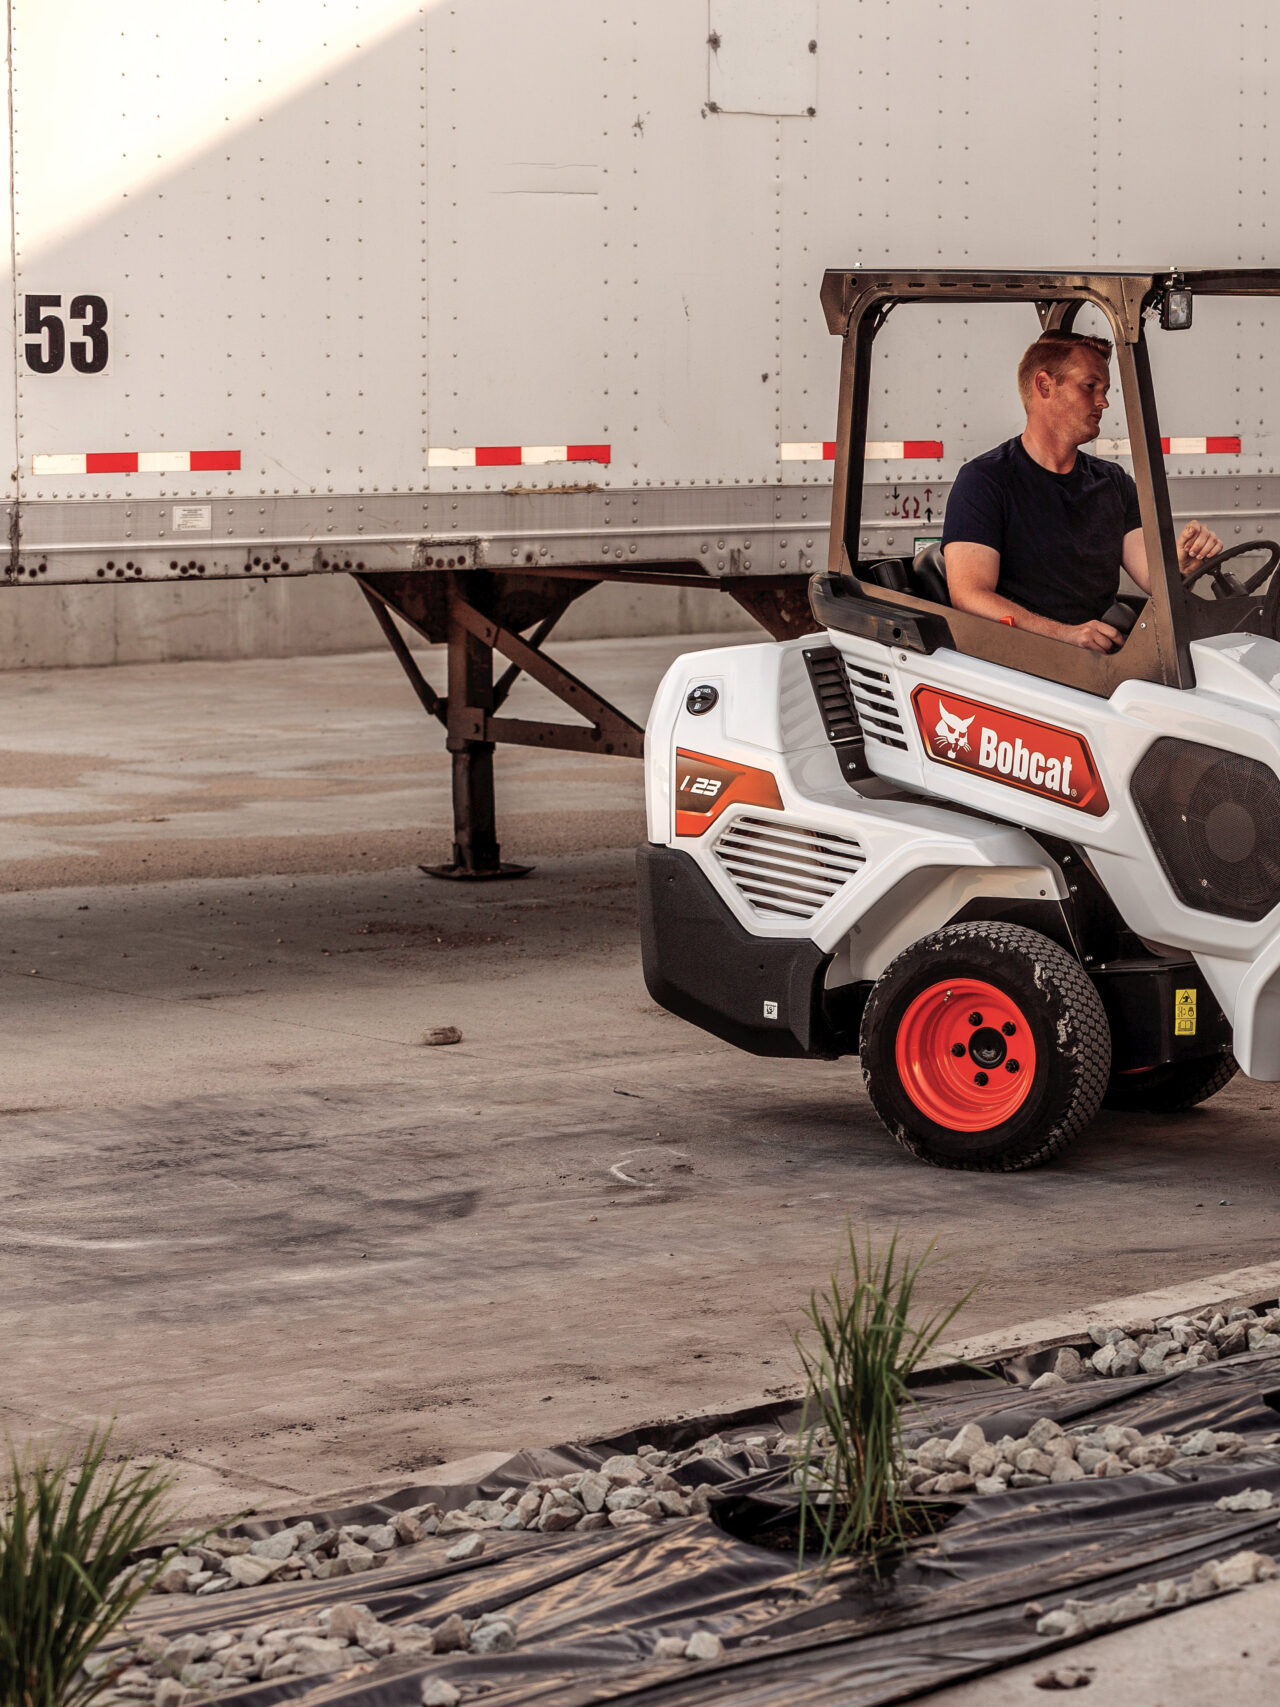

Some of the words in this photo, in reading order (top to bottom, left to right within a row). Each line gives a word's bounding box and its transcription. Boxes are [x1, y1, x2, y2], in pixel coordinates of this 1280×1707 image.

[24, 294, 109, 374] 53
[679, 775, 722, 797] L23
[978, 726, 1073, 796] Bobcat
